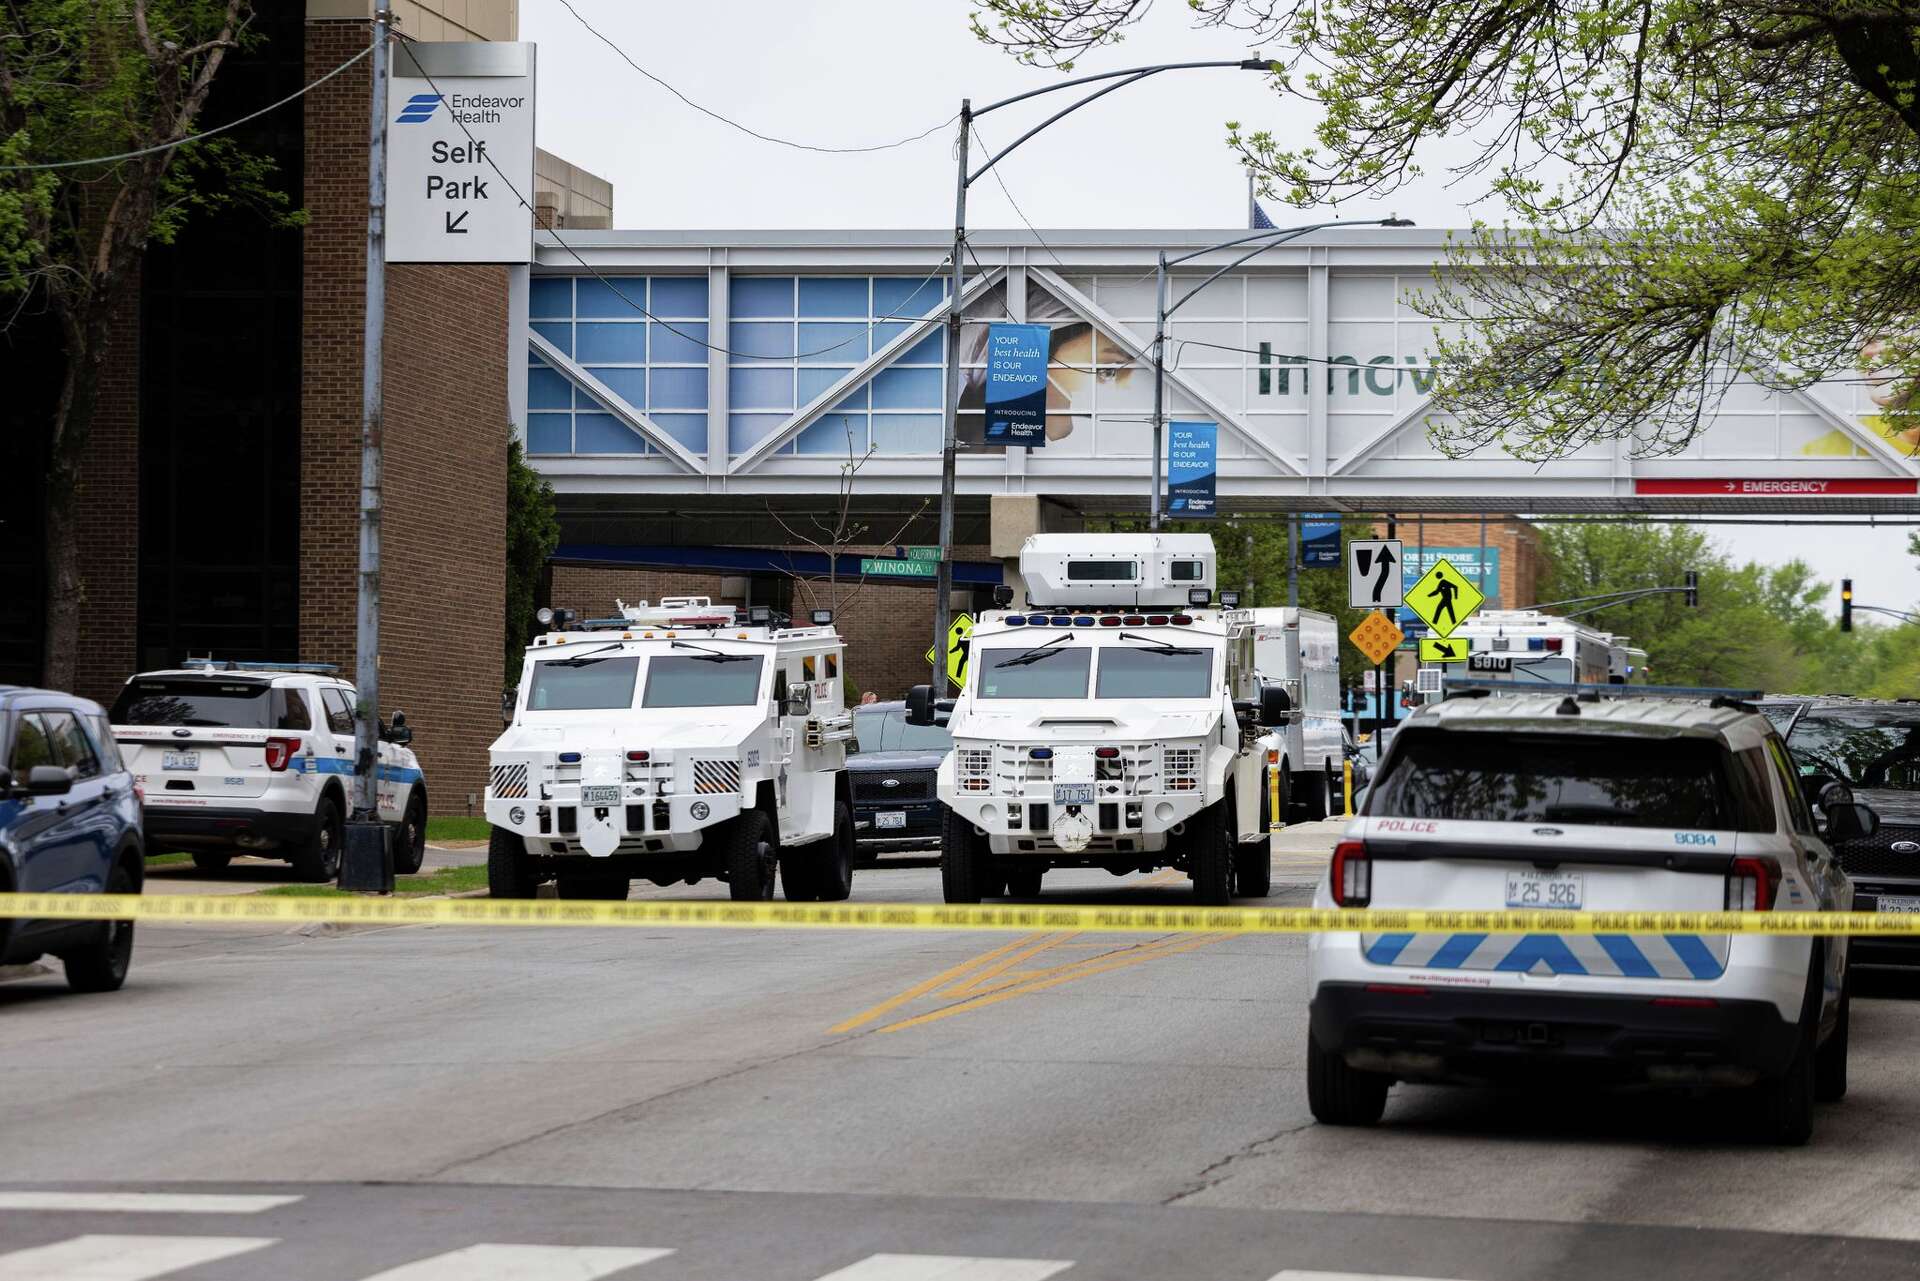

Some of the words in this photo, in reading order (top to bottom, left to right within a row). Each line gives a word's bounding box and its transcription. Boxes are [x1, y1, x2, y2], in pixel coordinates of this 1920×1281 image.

[452, 94, 524, 108] Endeavor
[452, 110, 500, 123] Health
[432, 140, 485, 164] Self
[427, 176, 488, 199] Park
[995, 336, 1018, 344] YOUR
[994, 348, 1011, 357] best
[1013, 348, 1040, 358] health
[993, 374, 1038, 382] ENDEAVOR
[1743, 481, 1828, 492] EMERGENCY
[1404, 553, 1434, 561] ORTH
[874, 562, 922, 574] WINONA
[1377, 820, 1438, 833] POLICE
[1674, 832, 1717, 846] 9084
[1522, 882, 1540, 903] 25
[1548, 883, 1576, 904] 926
[1206, 909, 1241, 927] CROSS
[1260, 910, 1296, 928] POLICE
[1301, 910, 1322, 928] LINE
[1327, 910, 1340, 928] DO
[1346, 911, 1366, 929] NOT
[1372, 911, 1407, 929] CROSS
[1426, 912, 1462, 930] POLICE
[1467, 912, 1488, 930] LINE
[1493, 912, 1506, 930] DO
[1512, 913, 1532, 931] NOT
[1538, 913, 1574, 931] CROSS
[1592, 914, 1629, 932] POLICE
[1634, 914, 1655, 932] LINE
[1661, 914, 1674, 932] DO
[1679, 915, 1700, 933] NOT
[1706, 915, 1742, 933] CROSS
[1760, 916, 1797, 934] POLICE
[1803, 916, 1824, 934] LINE
[1830, 916, 1842, 934] DO
[1848, 917, 1869, 935] NOT
[1875, 917, 1911, 935] CROSS
